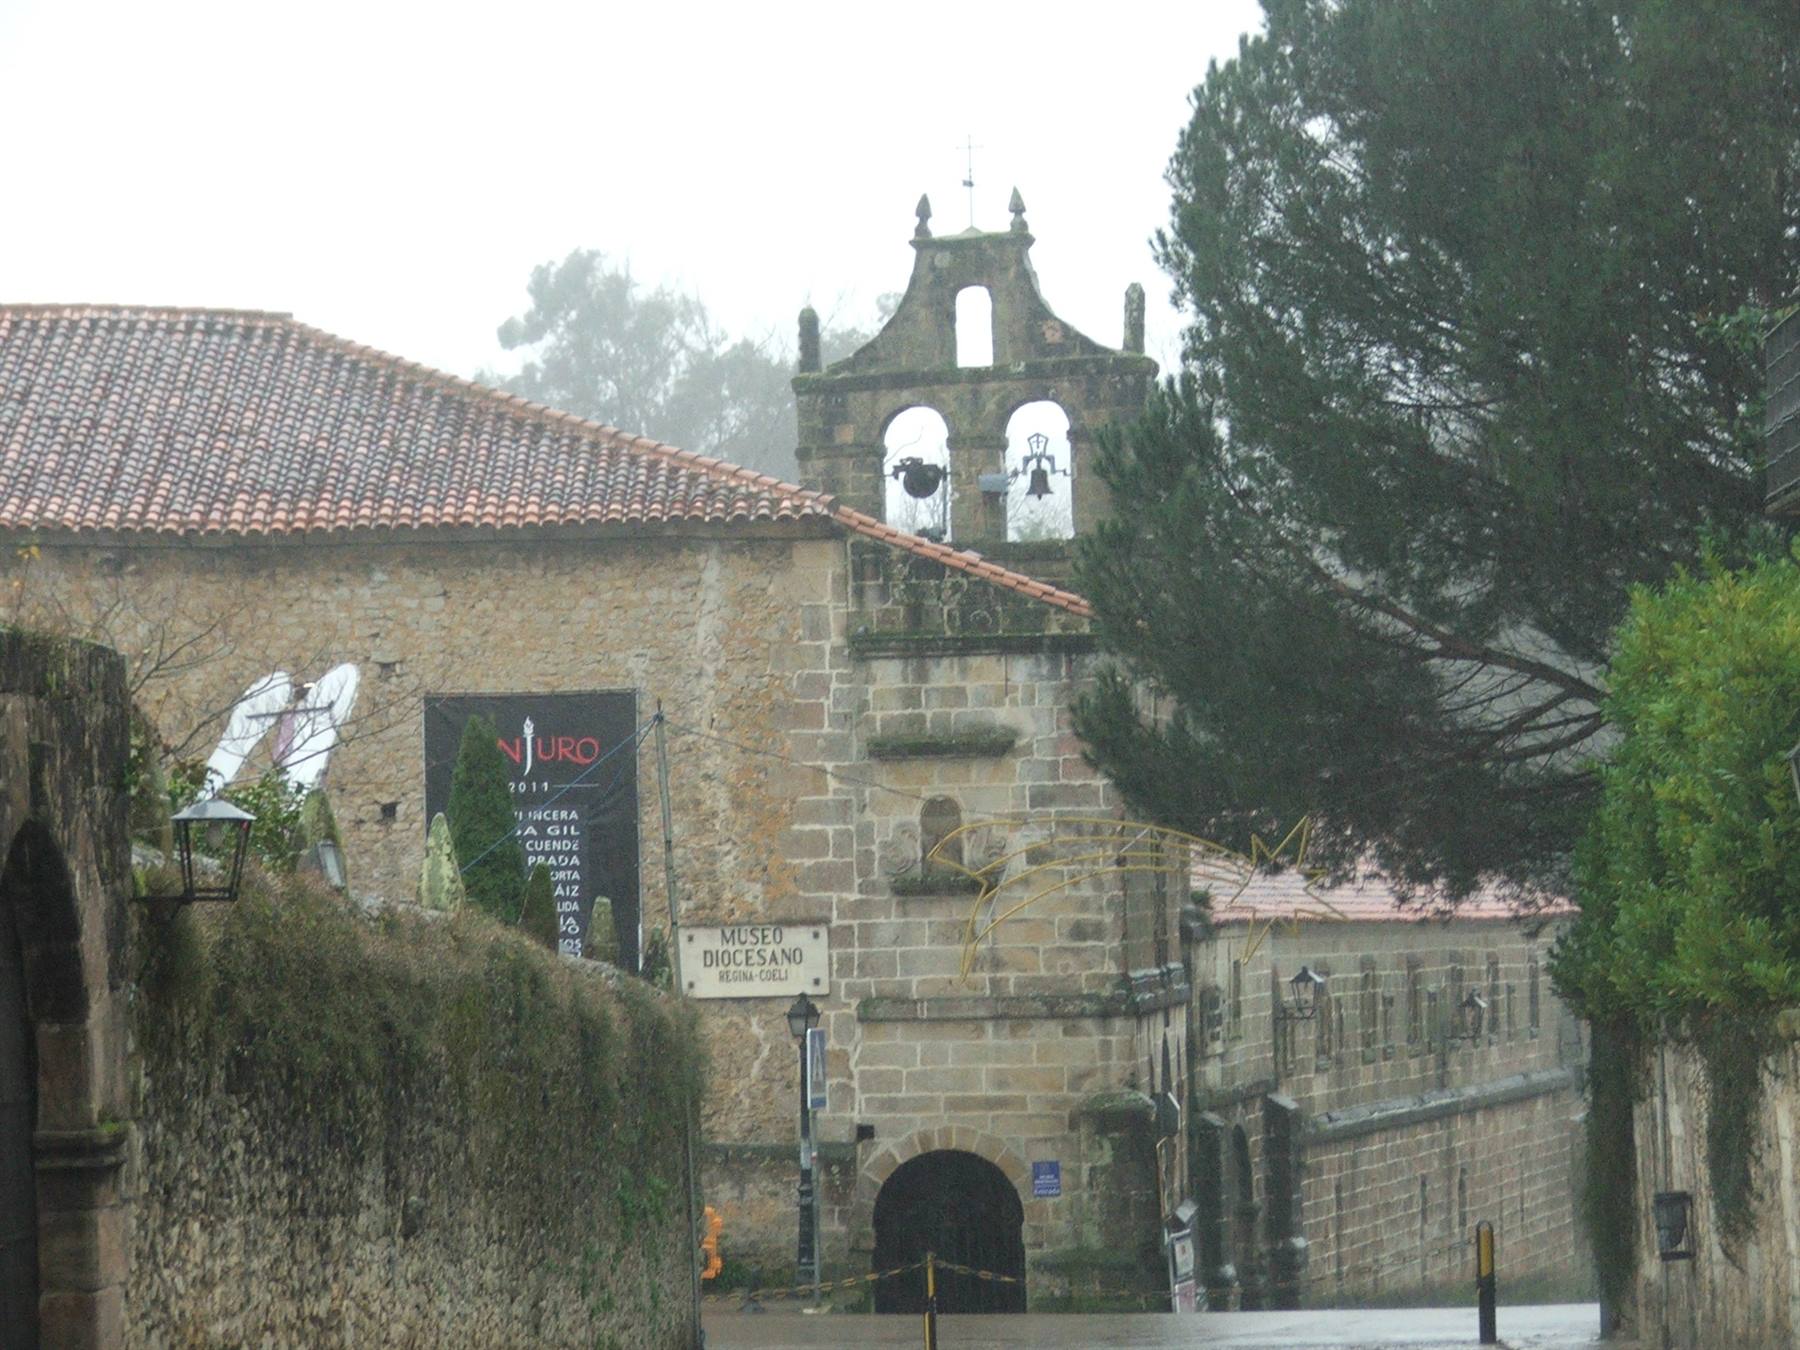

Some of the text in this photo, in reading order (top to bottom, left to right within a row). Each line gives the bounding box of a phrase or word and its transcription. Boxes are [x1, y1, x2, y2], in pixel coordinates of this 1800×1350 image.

[497, 716, 600, 776] NJURO
[508, 781, 549, 793] 2011
[547, 825, 580, 836] GIL
[528, 854, 581, 866] PRADA
[720, 926, 783, 946] MUSEO
[703, 947, 803, 968] DIOCESANO
